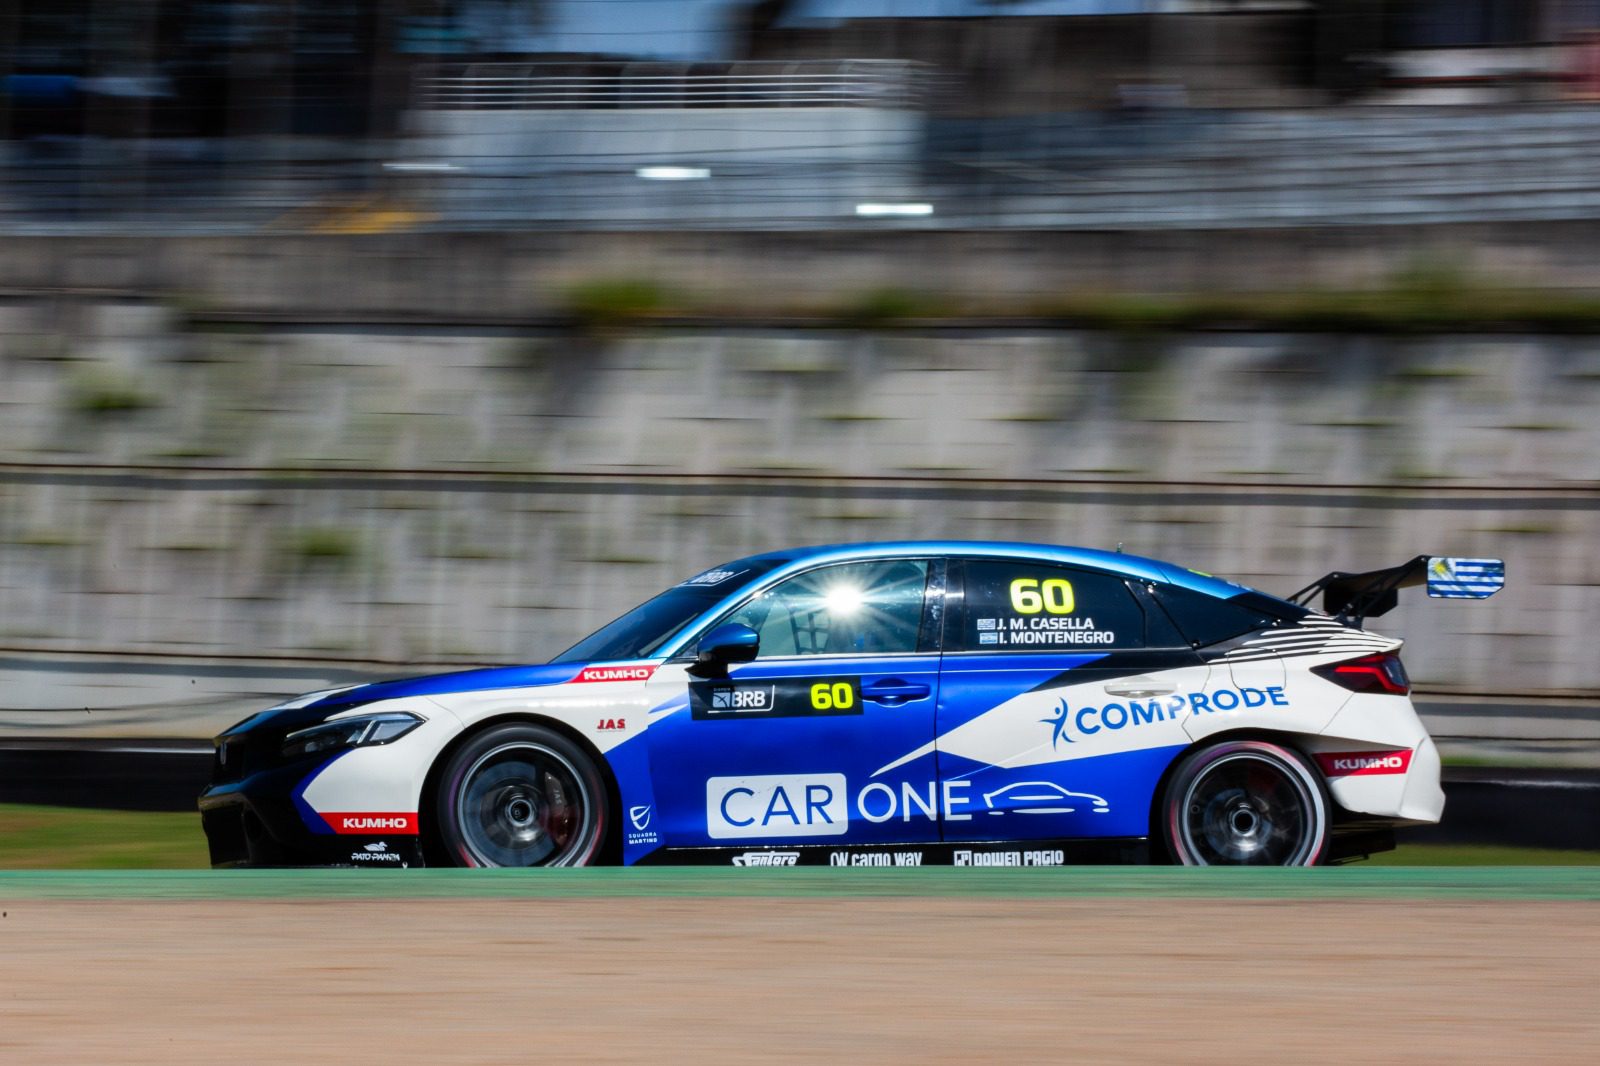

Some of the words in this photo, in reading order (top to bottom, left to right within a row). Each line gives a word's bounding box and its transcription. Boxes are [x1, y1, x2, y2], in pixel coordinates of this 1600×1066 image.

[1010, 578, 1075, 614] 60
[997, 618, 1007, 630] J.
[1010, 618, 1028, 630] M.
[1030, 617, 1095, 630] CASELLA
[999, 632, 1008, 644] I.
[1010, 631, 1115, 644] MONTENEGRO
[583, 669, 649, 680] KUMHO
[731, 691, 766, 708] BRB
[810, 682, 854, 710] 60
[1075, 686, 1289, 735] COMPRODE
[597, 718, 626, 729] JAS
[1334, 756, 1403, 770] KUMHO
[720, 784, 834, 827] CAR
[857, 780, 972, 823] ONE
[343, 817, 408, 829] KUMHO
